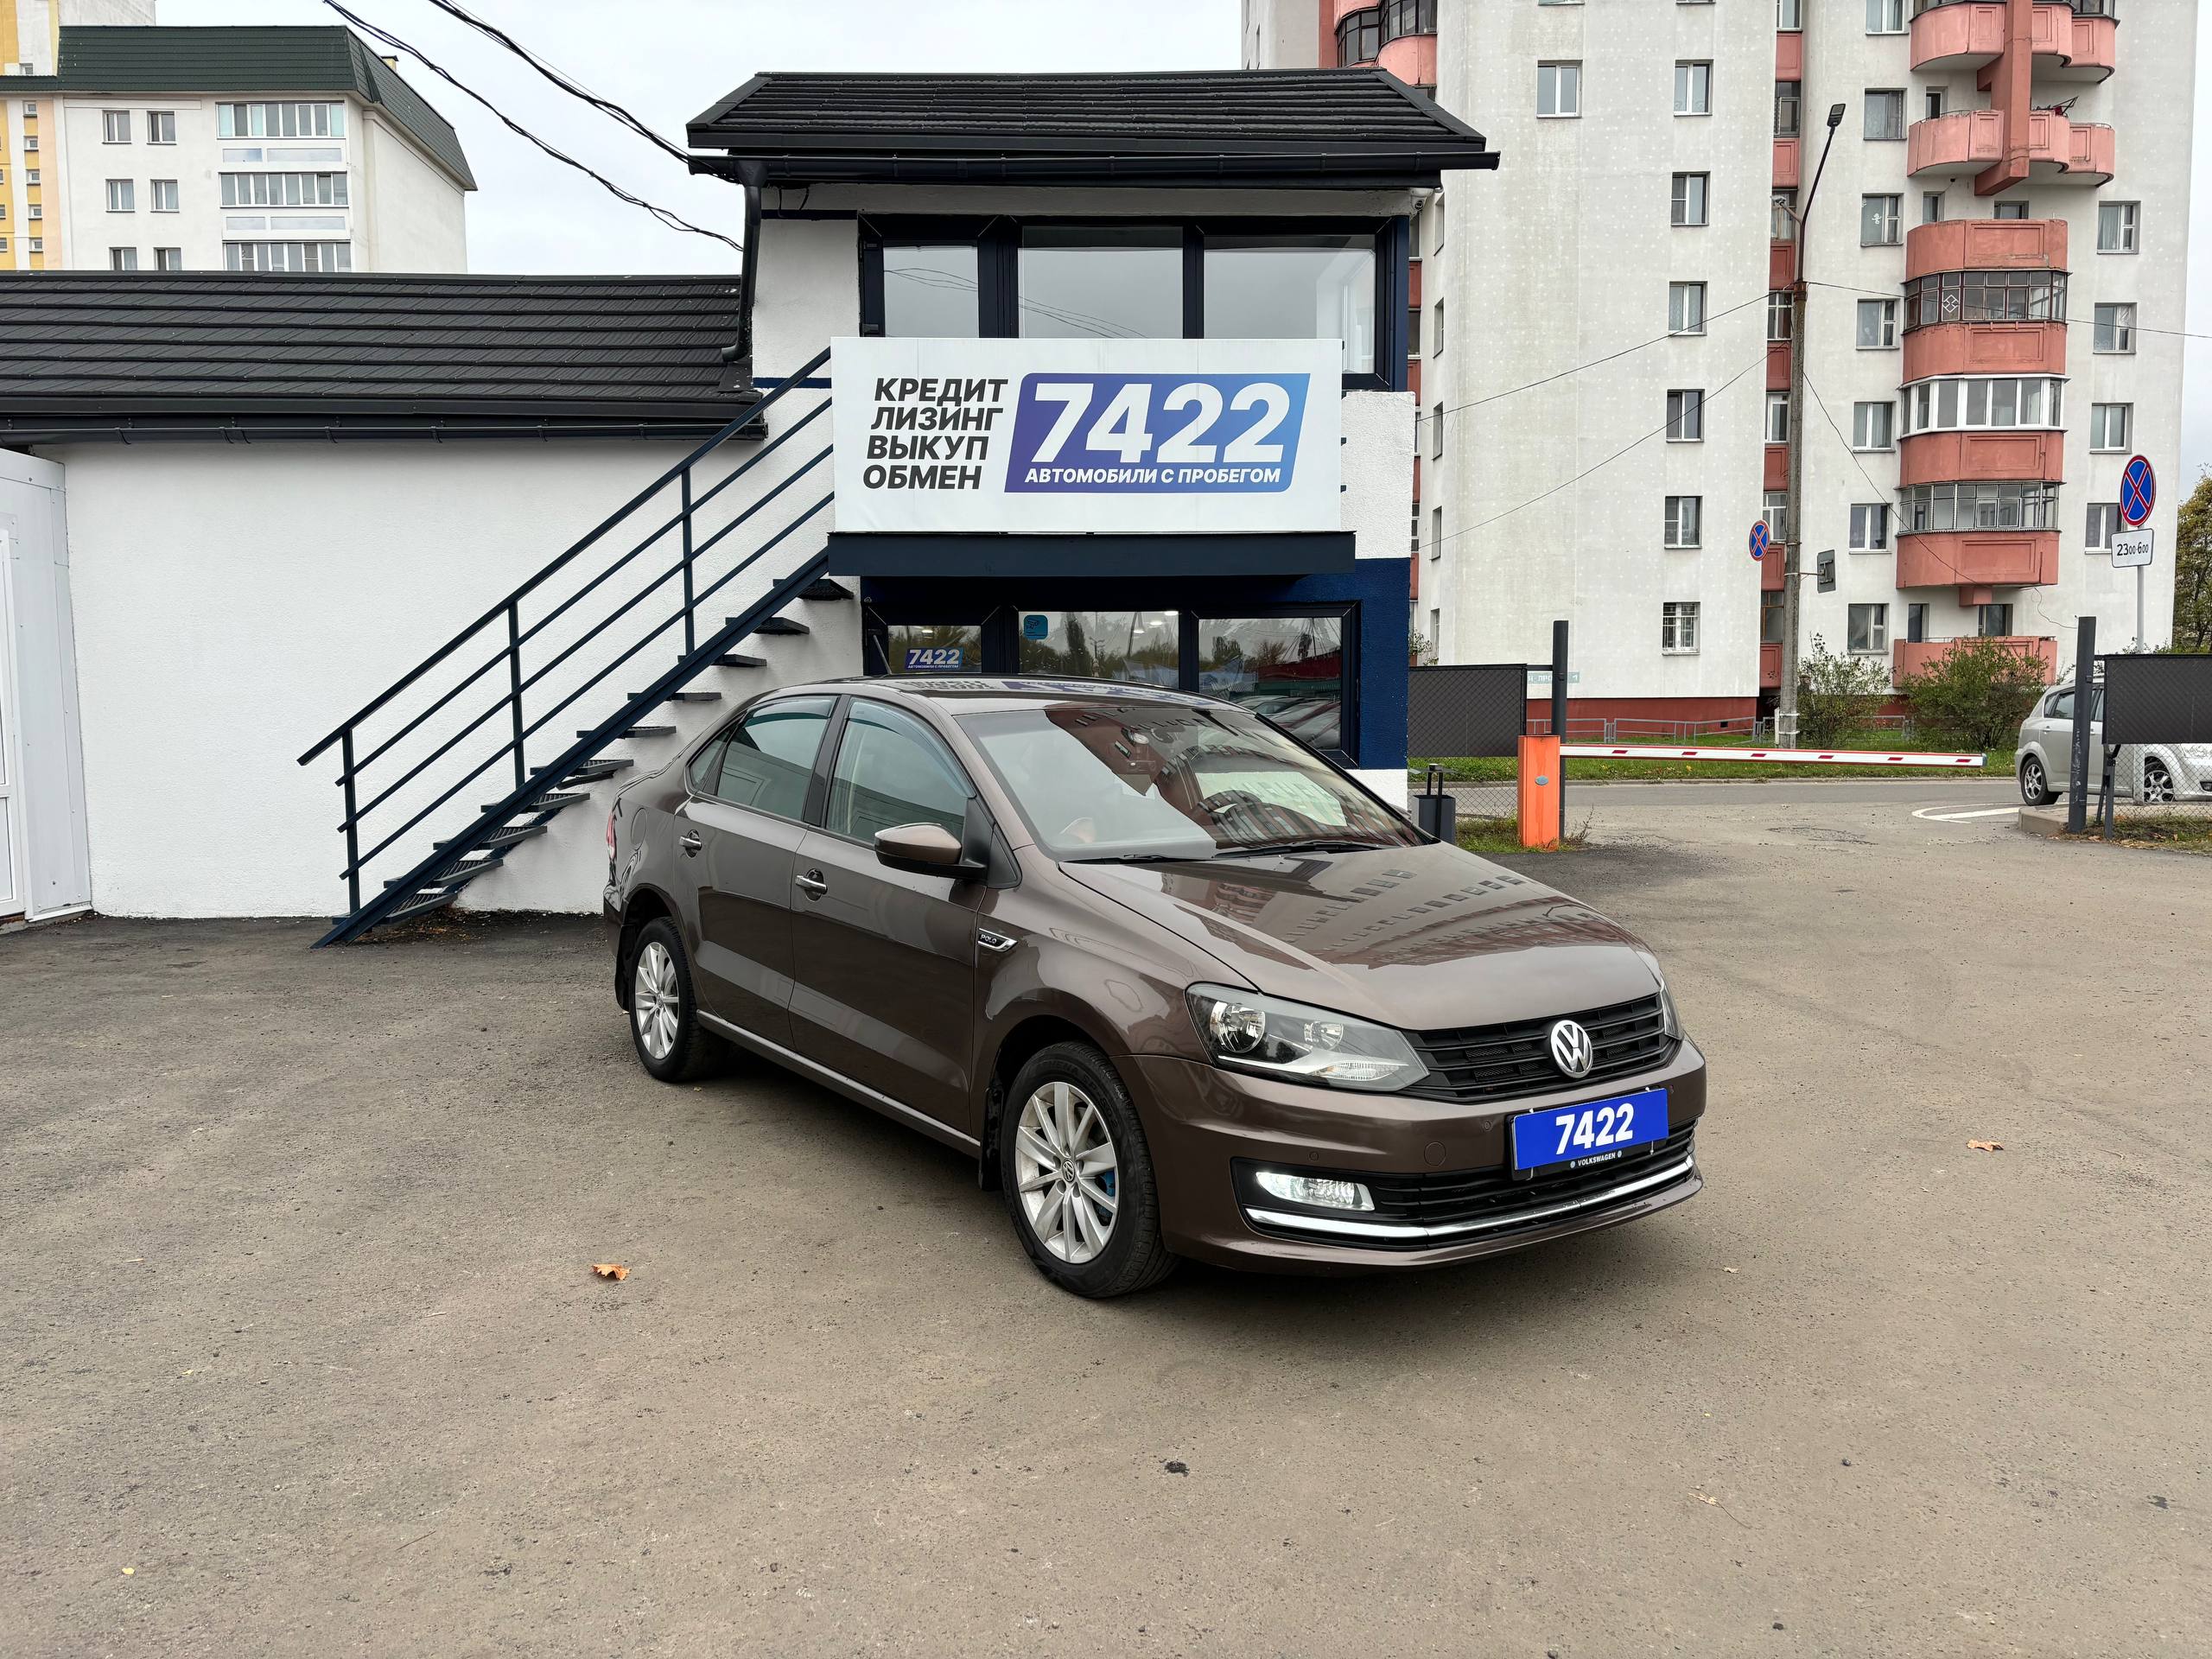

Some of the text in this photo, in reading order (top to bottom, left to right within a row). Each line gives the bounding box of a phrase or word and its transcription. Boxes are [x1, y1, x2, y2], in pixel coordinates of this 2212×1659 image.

[874, 378, 1008, 406] КРЕДИТ
[871, 407, 1003, 431] ЛИЗИНГ
[1031, 382, 1290, 463] 7422
[867, 435, 988, 460] ВЫКУП
[863, 464, 982, 489] ОБМЕН
[1025, 467, 1281, 484] АВТОМОБИЛИ С ПРОБЕГОМ
[909, 649, 960, 664] 7422
[980, 934, 997, 944] POLO
[1555, 1103, 1634, 1156] 7422
[1578, 1152, 1616, 1167] VOLKSWAGEN
